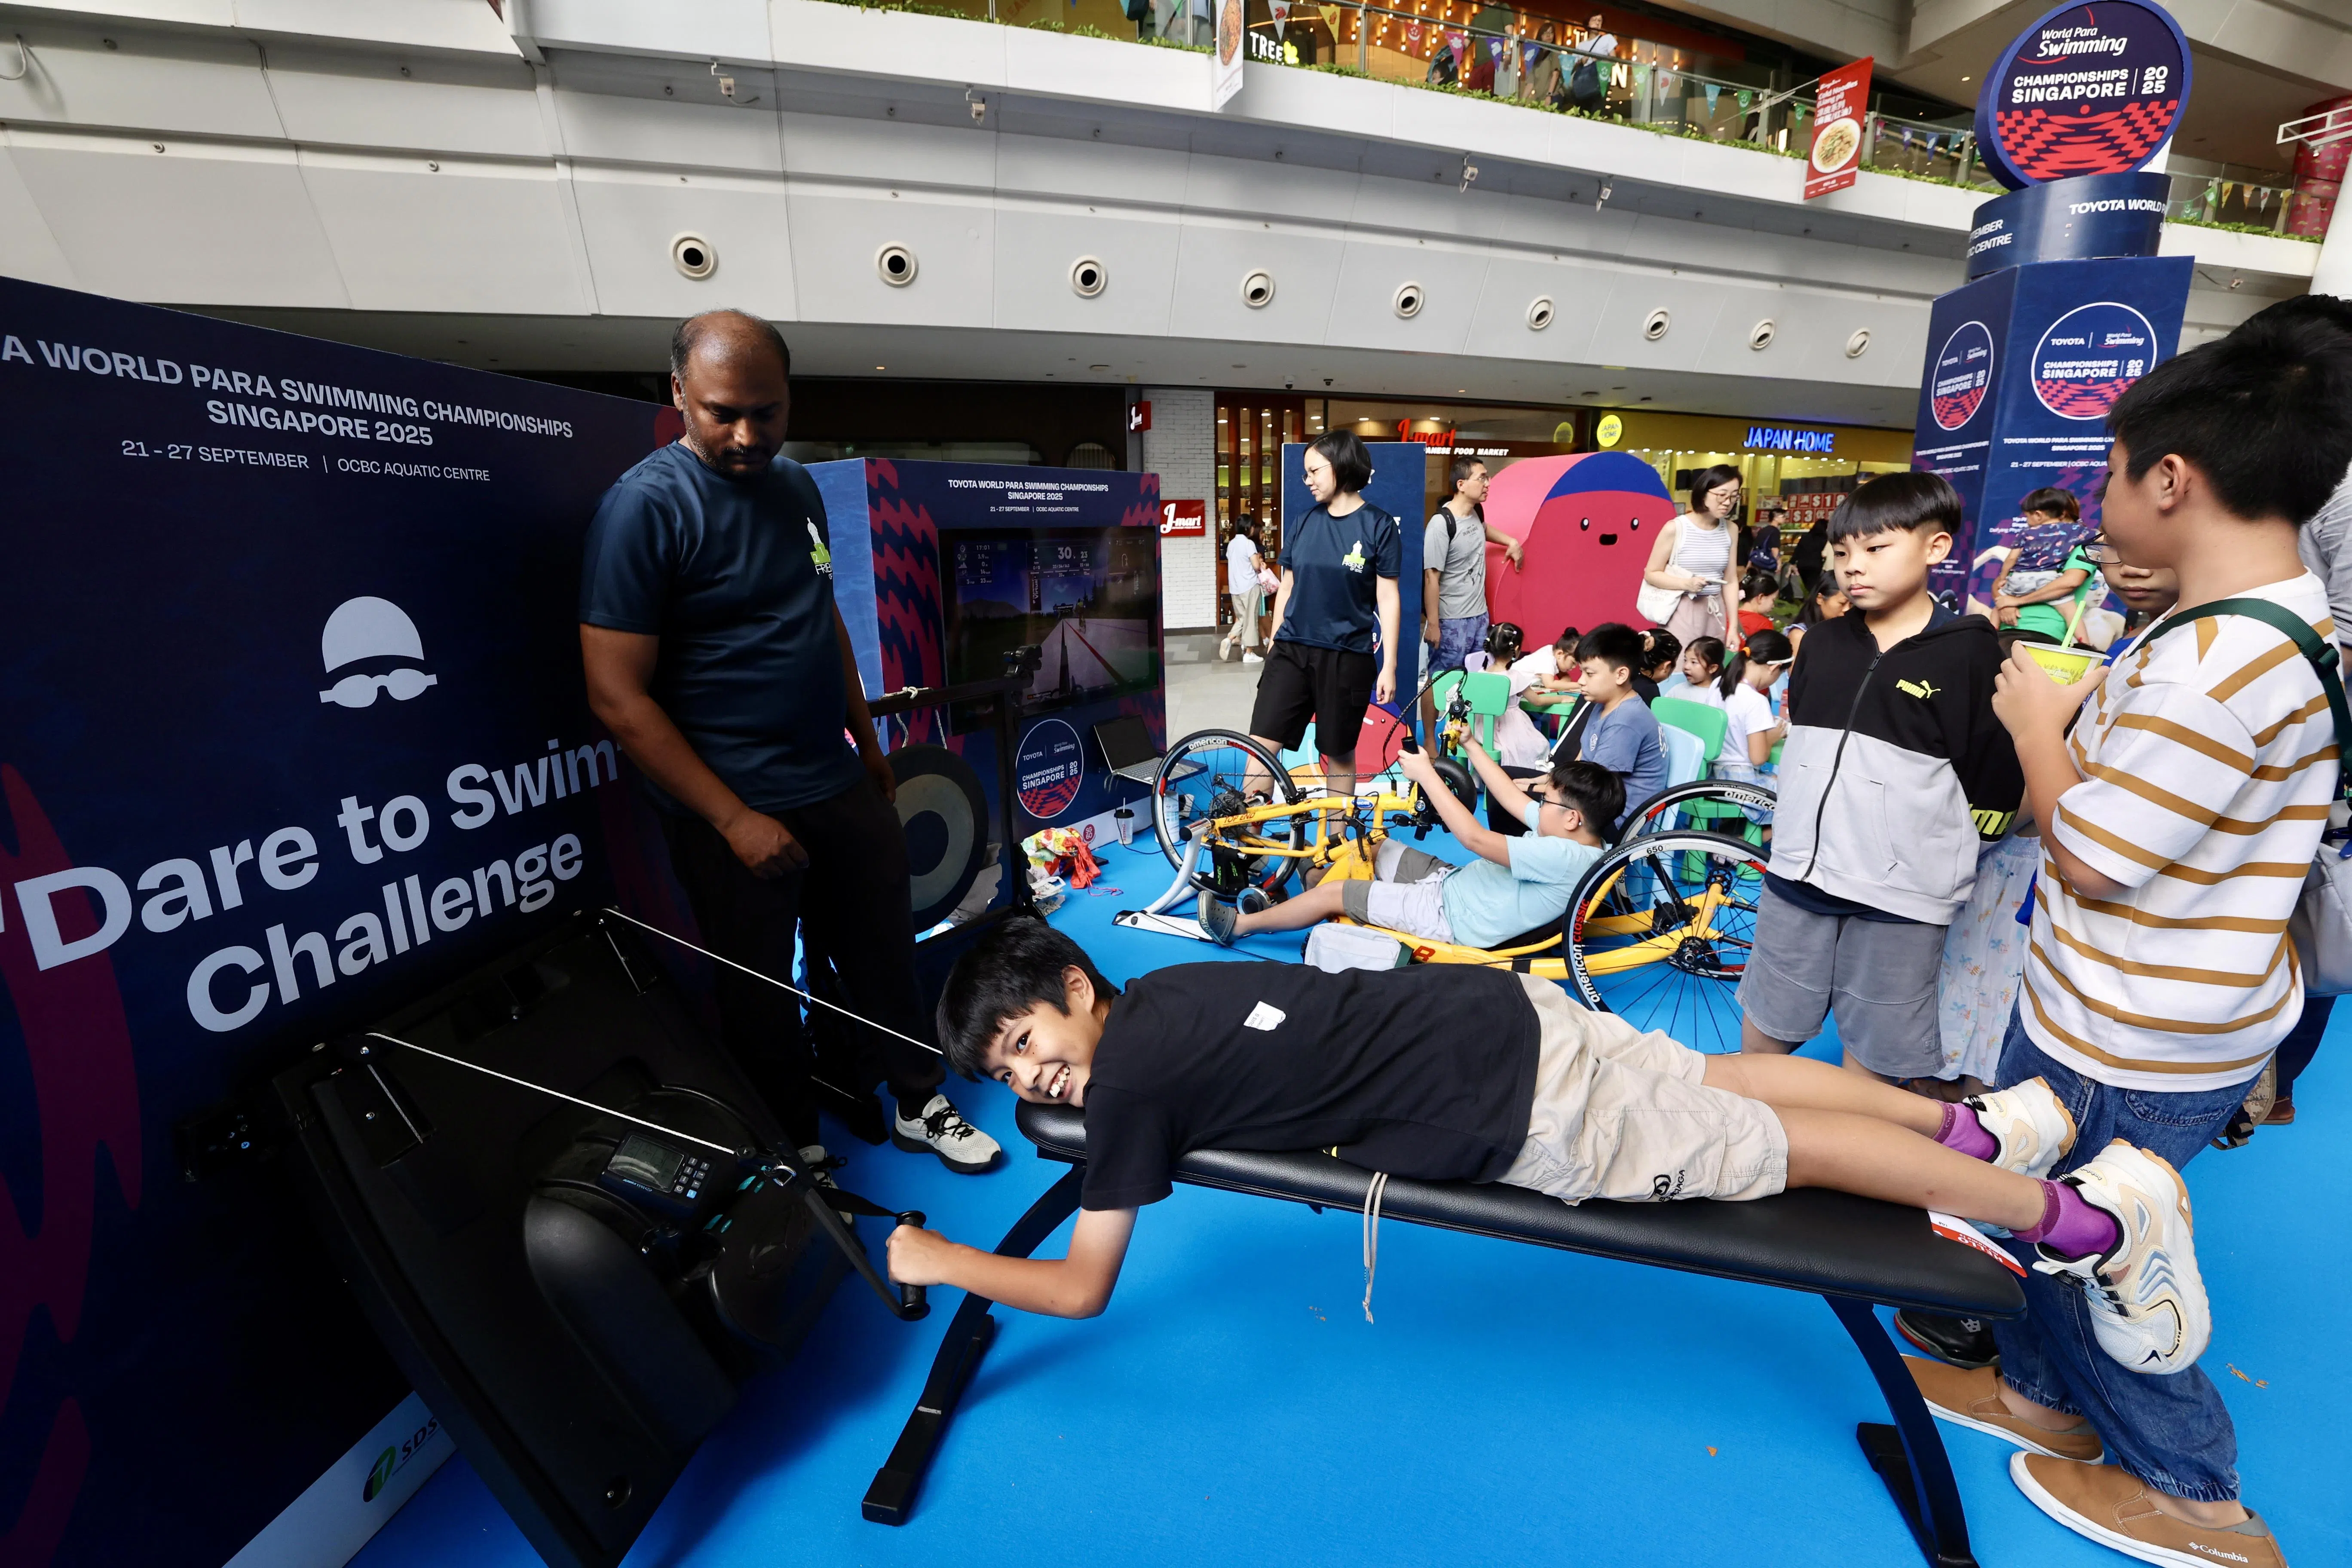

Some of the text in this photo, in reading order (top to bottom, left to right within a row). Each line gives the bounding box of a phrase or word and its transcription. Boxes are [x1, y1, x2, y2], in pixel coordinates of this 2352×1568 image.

[2042, 28, 2098, 40] World Para
[2037, 35, 2127, 57] Swimming
[2014, 69, 2129, 88] CHAMPIONSHIPS
[2141, 66, 2168, 95] 20 25
[2012, 83, 2126, 104] SINGAPORE
[2069, 199, 2124, 214] TOYOTA
[2128, 199, 2162, 213] WORLD
[1976, 233, 2013, 253] CENTRE
[2051, 336, 2145, 346] TOYOTA Swimming
[2042, 368, 2117, 379] SINGAPORE
[2043, 360, 2119, 368] CHAMPIONSHIPS
[2125, 359, 2144, 377] 20 25
[37, 340, 182, 383] WORLD
[190, 364, 276, 398] PARA
[281, 379, 419, 417] SWIMMING
[423, 401, 572, 438] CHAMPIONSHIPS
[207, 401, 432, 445] SINGAPORE 2025
[1743, 426, 1835, 453] JAPAN HOME
[122, 441, 149, 456] 21
[168, 444, 192, 459] 27
[199, 447, 309, 468] SEPTEMBER
[338, 459, 380, 473] OCBC
[385, 462, 440, 477] AQUATIC
[444, 467, 490, 481] CENTRE
[948, 479, 1109, 492] TOYOTA WORLD PARA SWIMMING CHAMPIONSHIPS
[1008, 491, 1063, 501] SINGAPORE 2025
[1160, 503, 1201, 534] J-mart
[1342, 561, 1363, 570] FRIEND
[1896, 679, 1927, 699] PUMA
[1023, 743, 1075, 761] TOYOTA Swimming
[1188, 738, 1228, 751] american
[1022, 764, 1064, 782] CHAMPIONSHIPS
[1023, 772, 1065, 790] SINGAPORE
[1069, 768, 1078, 776] 25
[1223, 812, 1256, 824] TOP END
[337, 795, 430, 864] to
[1604, 845, 1630, 864] INVICTUS
[1574, 898, 1590, 943] classic
[187, 833, 583, 1032] Challenge
[1574, 943, 1601, 1003] american
[1958, 1237, 2003, 1263] HELLO
[2199, 1545, 2248, 1563] Columbia
